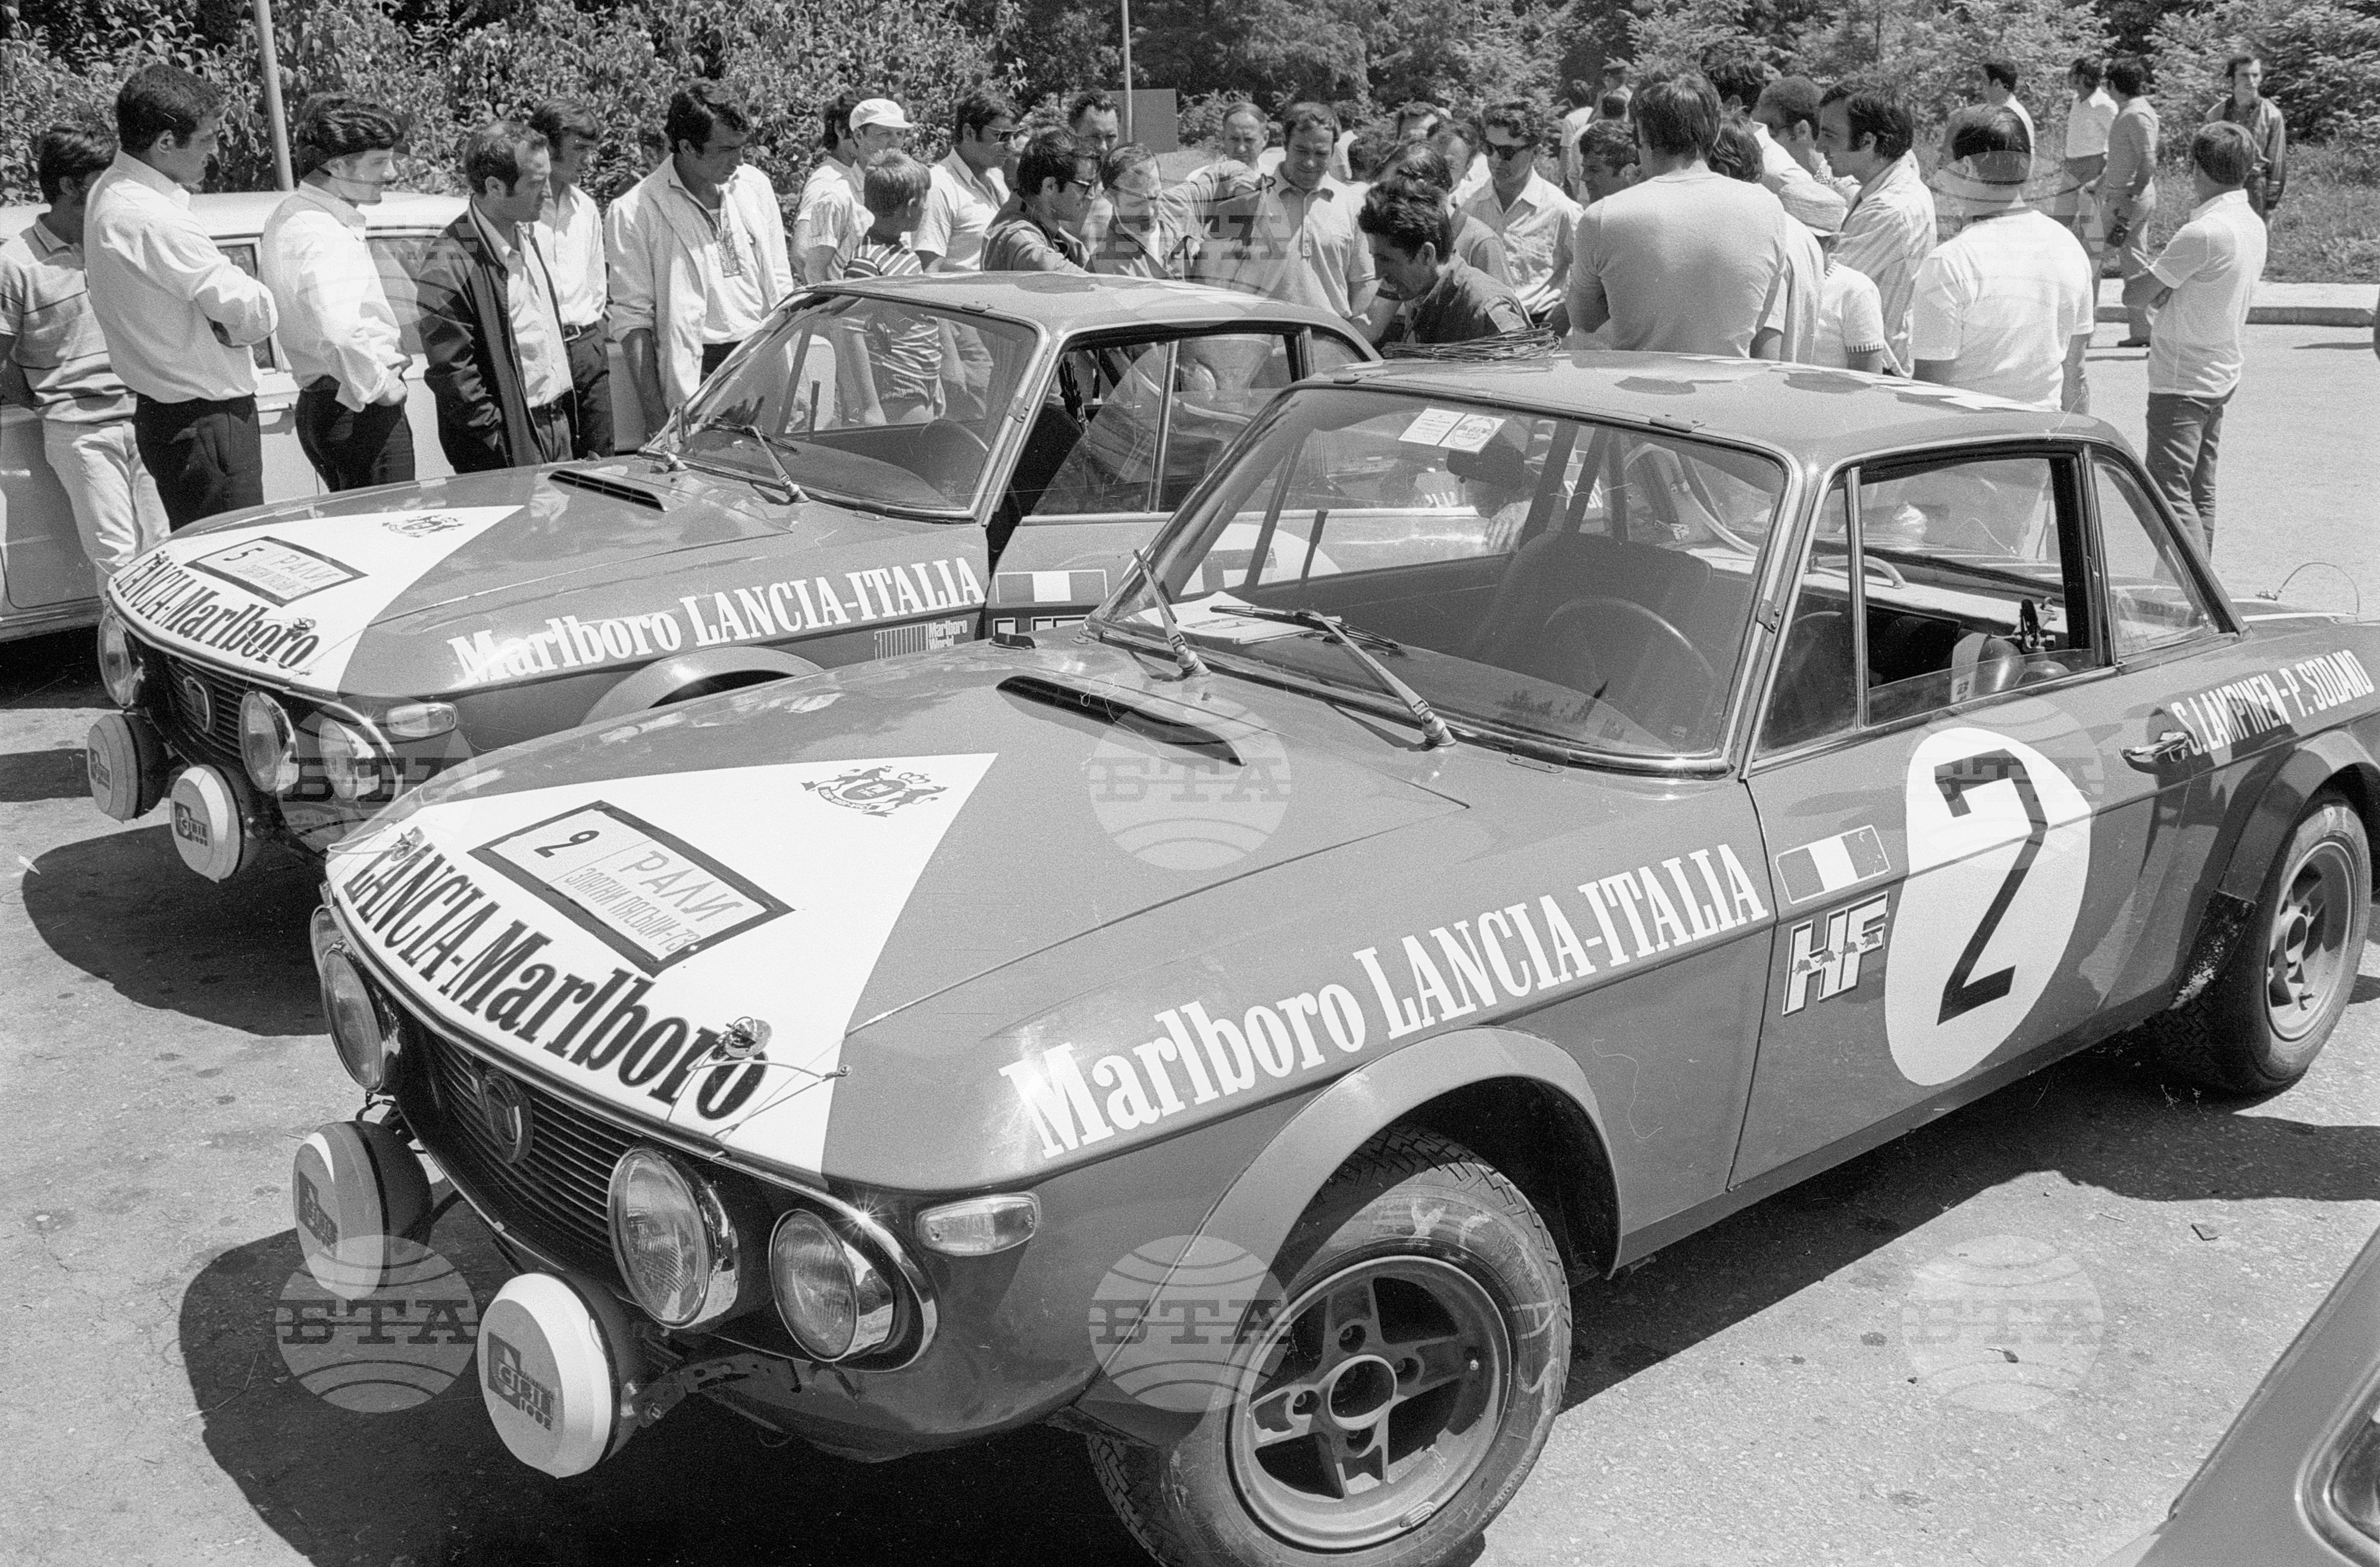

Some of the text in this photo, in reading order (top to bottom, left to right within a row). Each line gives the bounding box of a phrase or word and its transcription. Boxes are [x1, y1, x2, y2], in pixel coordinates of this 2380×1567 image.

[223, 547, 265, 562] 5
[447, 557, 987, 683] Marlboro LANCIA-ITALIA
[928, 620, 967, 638] Marlboro
[533, 830, 600, 858] 2
[563, 867, 632, 907] ЗЛАТНИ
[617, 850, 743, 922] РАЛИ
[1934, 748, 2049, 1026] 2
[1782, 891, 1889, 1016] HF
[1000, 844, 1769, 1159] Marlboro LANCIA-ITALIA
